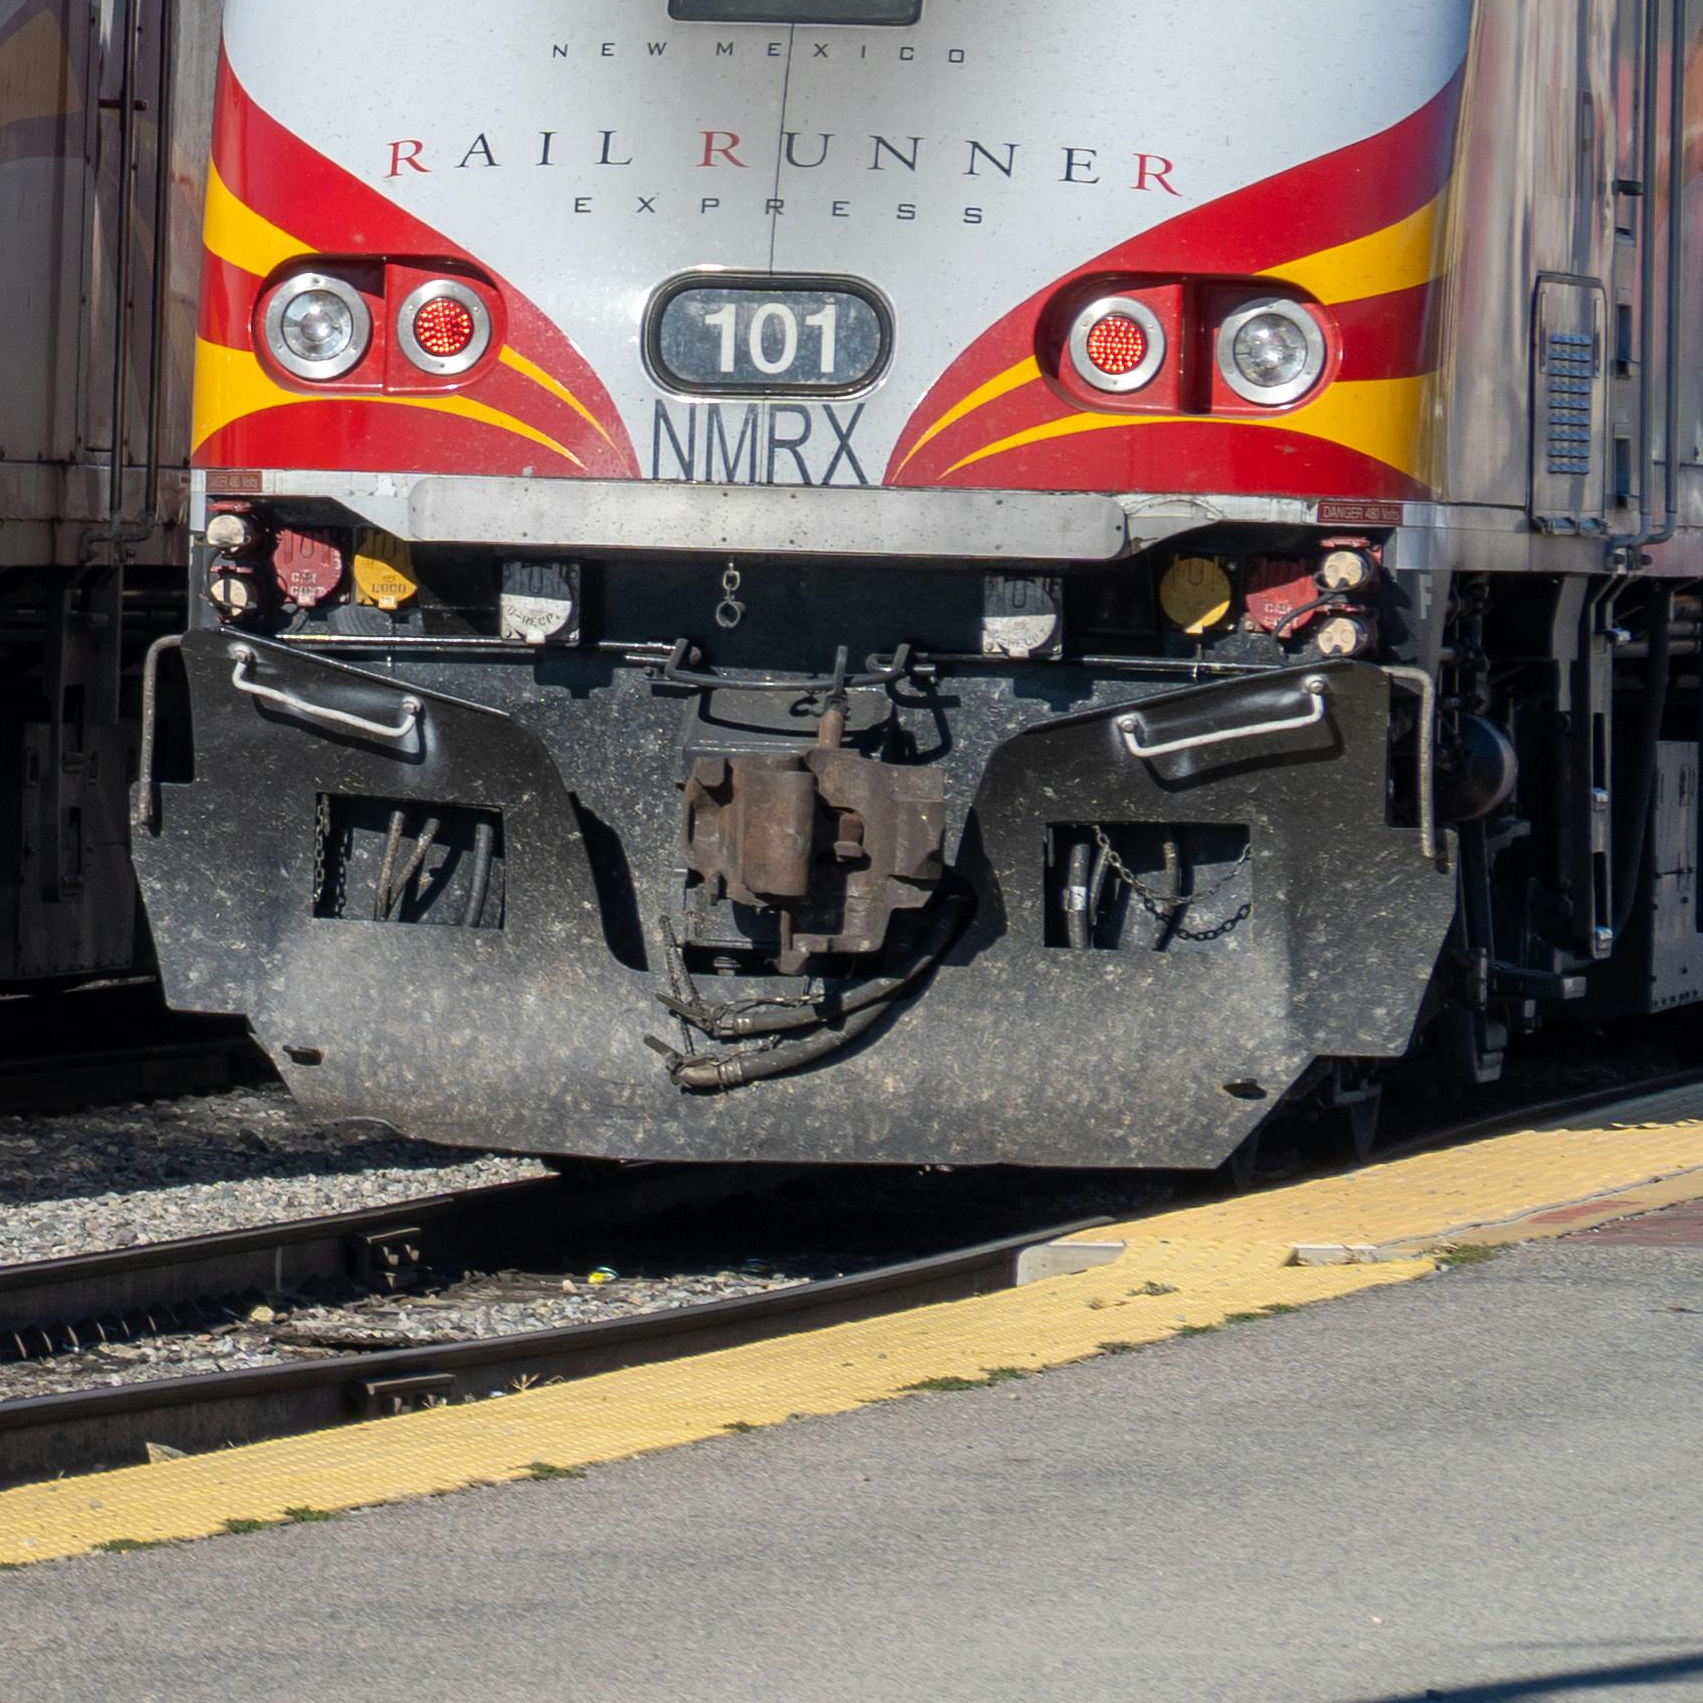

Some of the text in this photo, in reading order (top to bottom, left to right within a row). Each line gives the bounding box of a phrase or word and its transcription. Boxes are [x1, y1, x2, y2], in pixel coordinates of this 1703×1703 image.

[553, 42, 966, 63] NEW MEXICO
[385, 130, 1183, 197] RAIL RUNNER
[574, 197, 983, 225] EXPRESS
[704, 301, 837, 374] 101
[653, 401, 868, 485] NMRX
[1323, 505, 1362, 519] DANGER
[372, 584, 406, 594] LOCO
